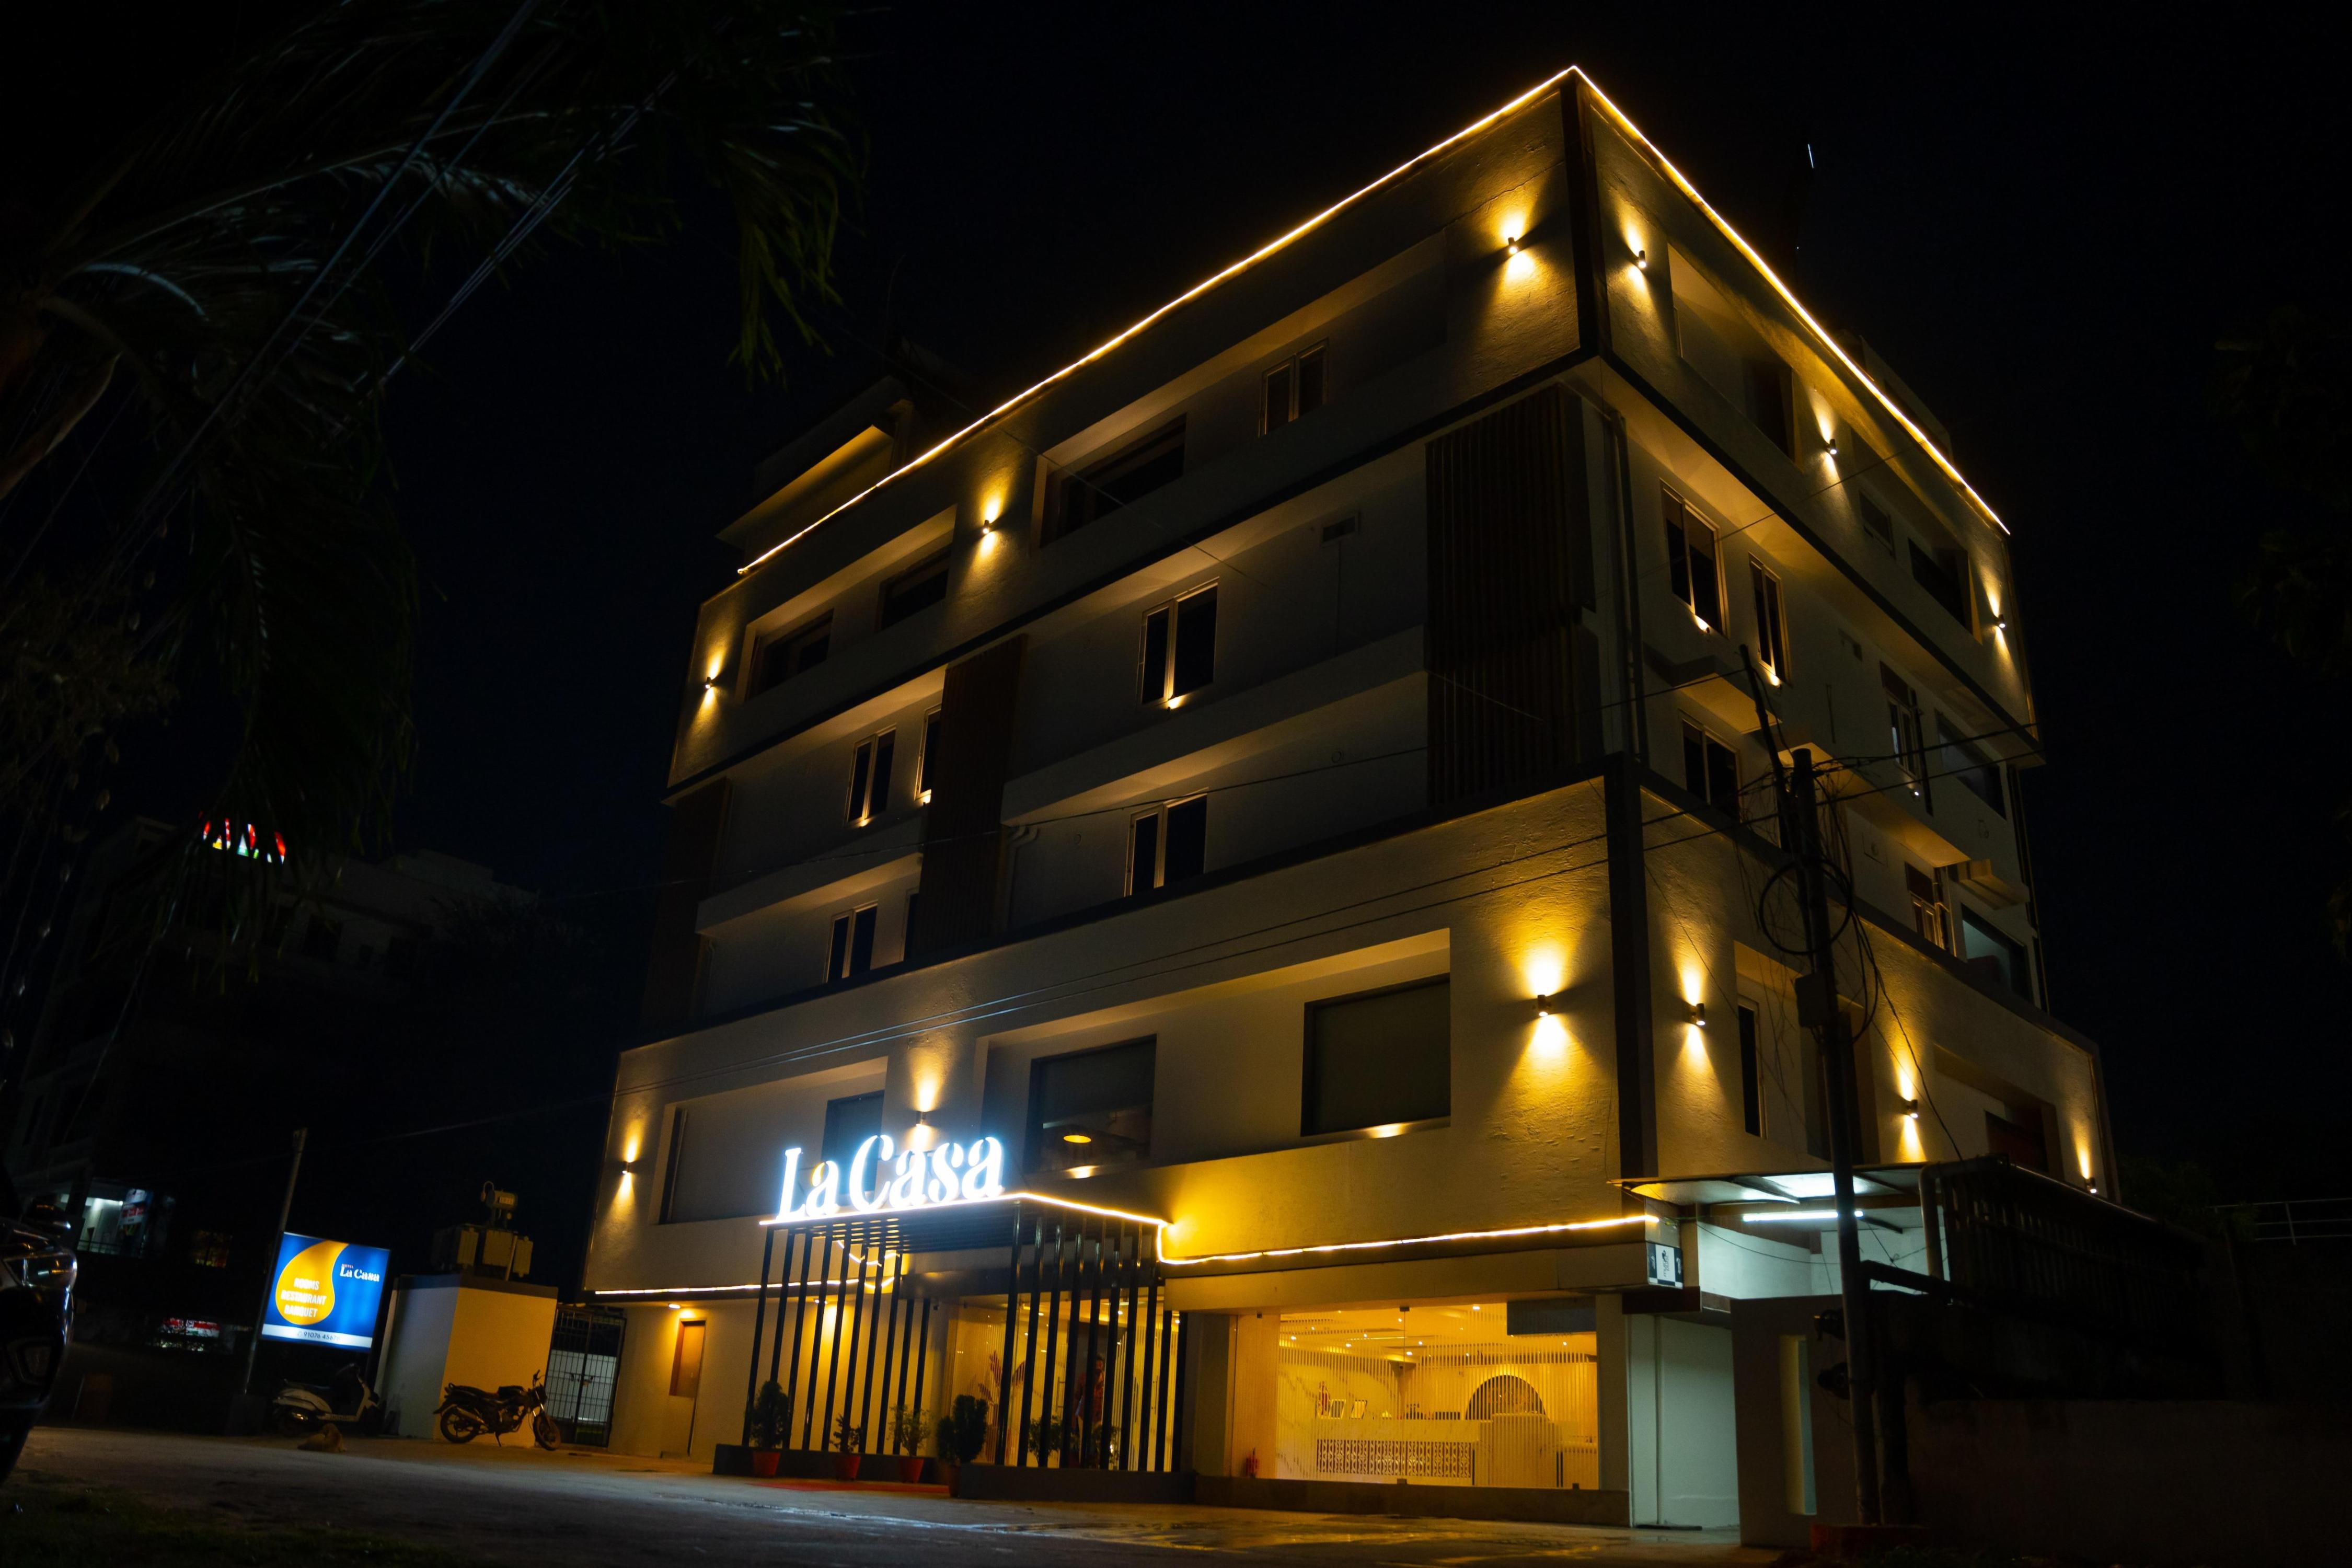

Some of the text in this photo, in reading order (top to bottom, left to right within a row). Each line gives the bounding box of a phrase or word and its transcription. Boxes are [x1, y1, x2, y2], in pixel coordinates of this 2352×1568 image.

[776, 1135, 1005, 1220] La Casa
[340, 1265, 380, 1282] La Casa
